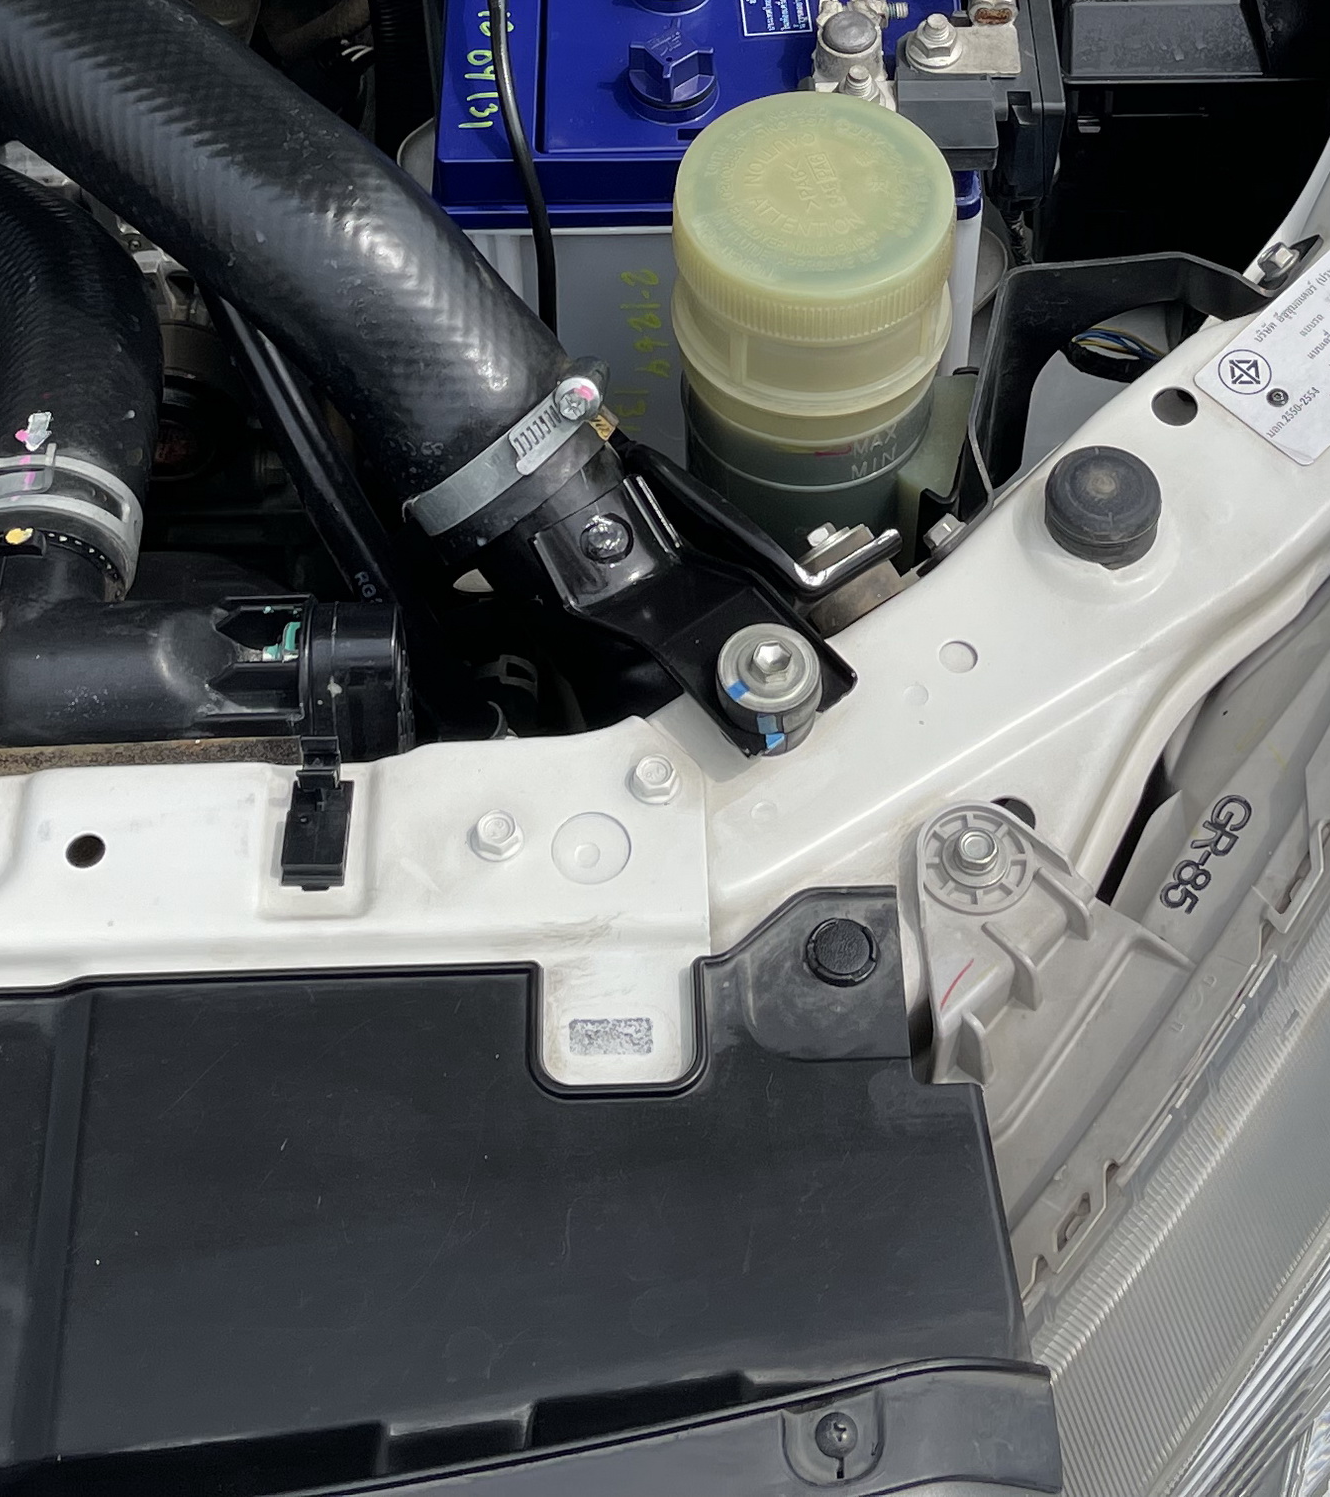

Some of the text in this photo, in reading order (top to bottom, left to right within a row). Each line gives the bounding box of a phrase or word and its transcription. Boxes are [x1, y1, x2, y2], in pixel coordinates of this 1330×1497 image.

[1253, 321, 1276, 342] บริษัท
[1299, 313, 1324, 336] แบบรถ
[853, 423, 897, 458] MAX
[851, 443, 897, 479] MIN
[1159, 793, 1253, 916] GR-85
